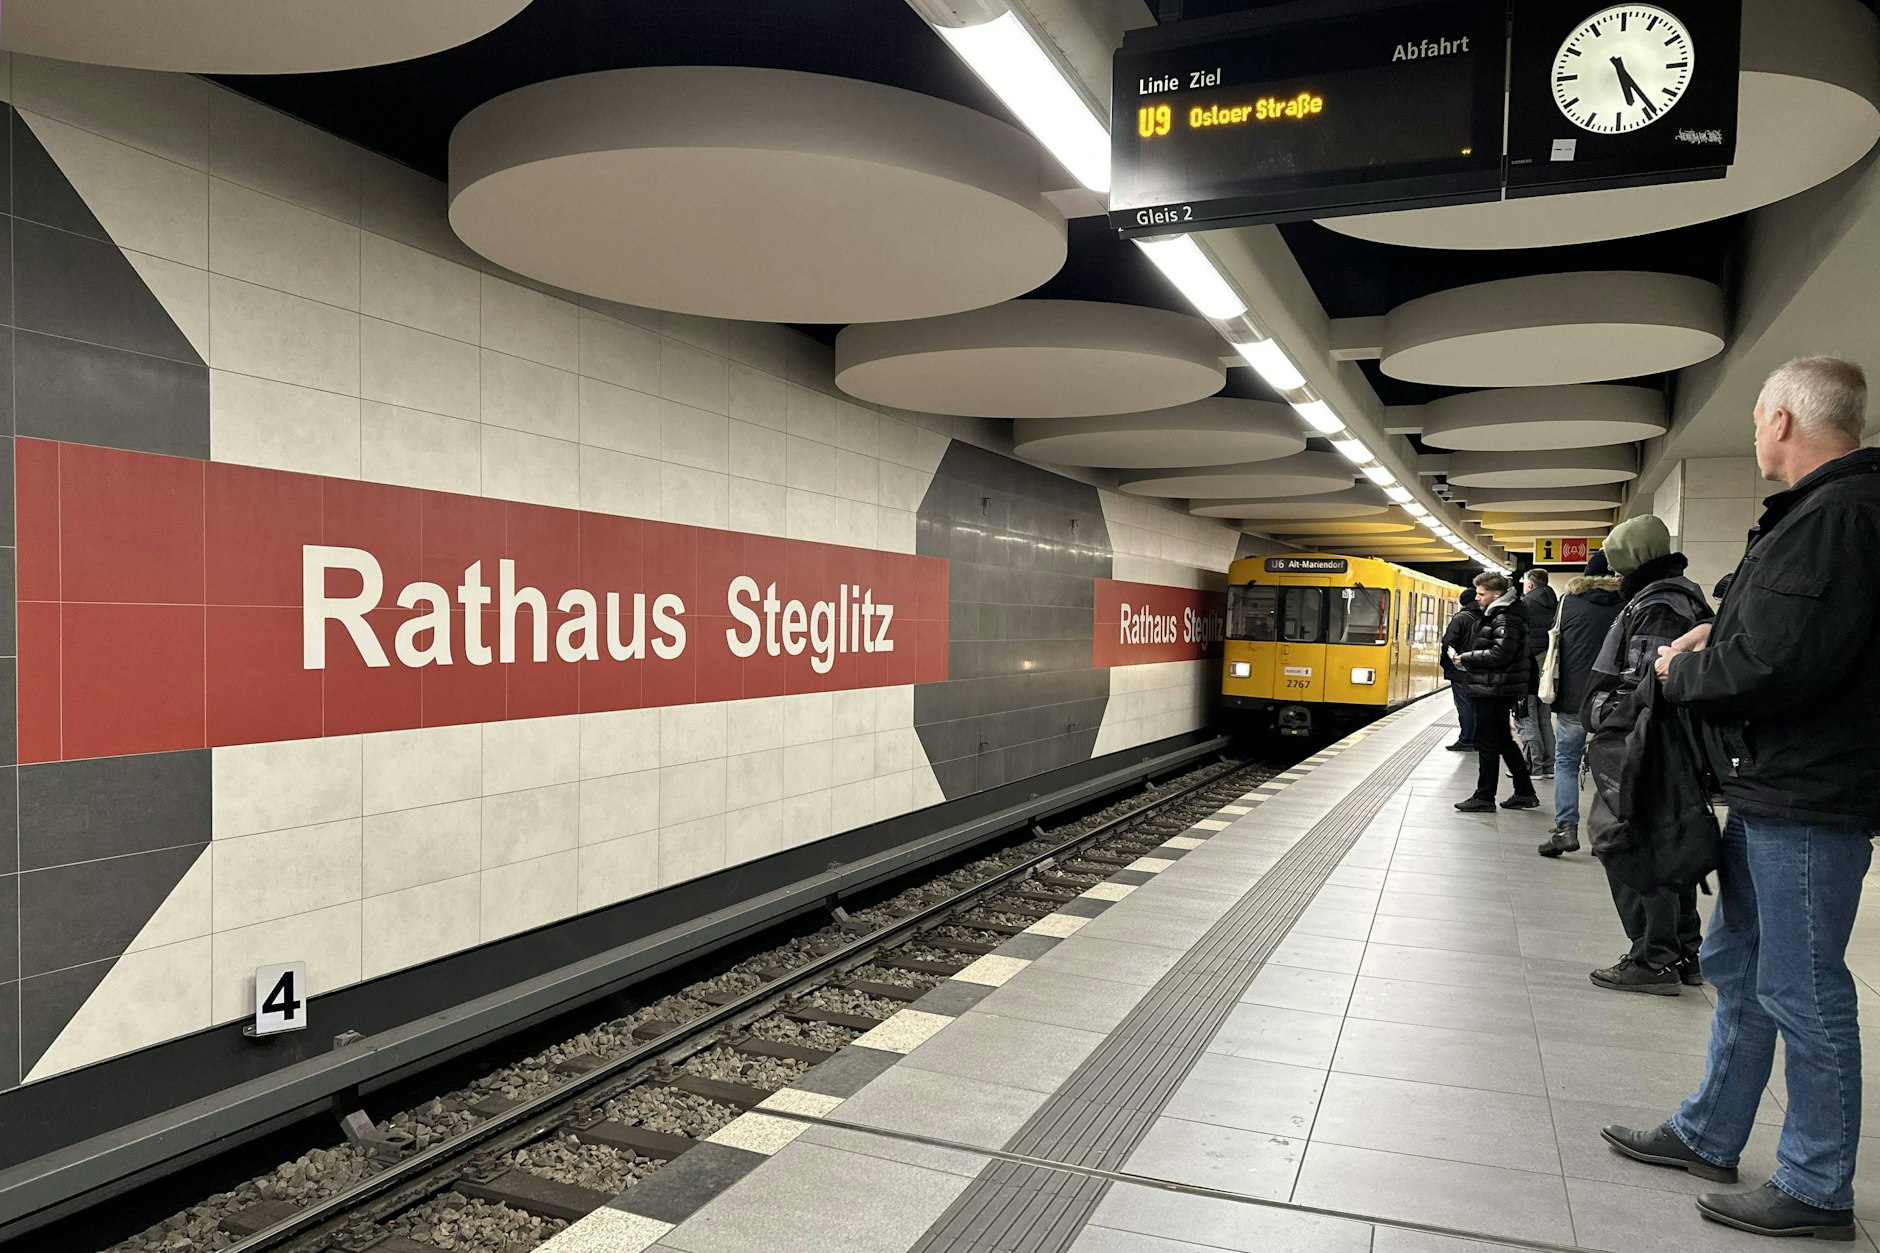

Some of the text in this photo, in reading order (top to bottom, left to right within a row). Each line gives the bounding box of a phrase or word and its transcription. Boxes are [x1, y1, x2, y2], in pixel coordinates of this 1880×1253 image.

[1392, 36, 1469, 62] Abfahrt
[1139, 68, 1221, 95] Linie Ziel
[1138, 92, 1323, 137] U9 Osloer Straße
[1136, 205, 1193, 225] Gleis 2
[1271, 559, 1344, 570] U6 Alt-Mariendorf
[302, 543, 895, 674] Rathaus Steglitz
[1120, 603, 1223, 651] Rathaus Steglitz
[1287, 679, 1311, 689] 2767
[262, 970, 301, 1021] 4
